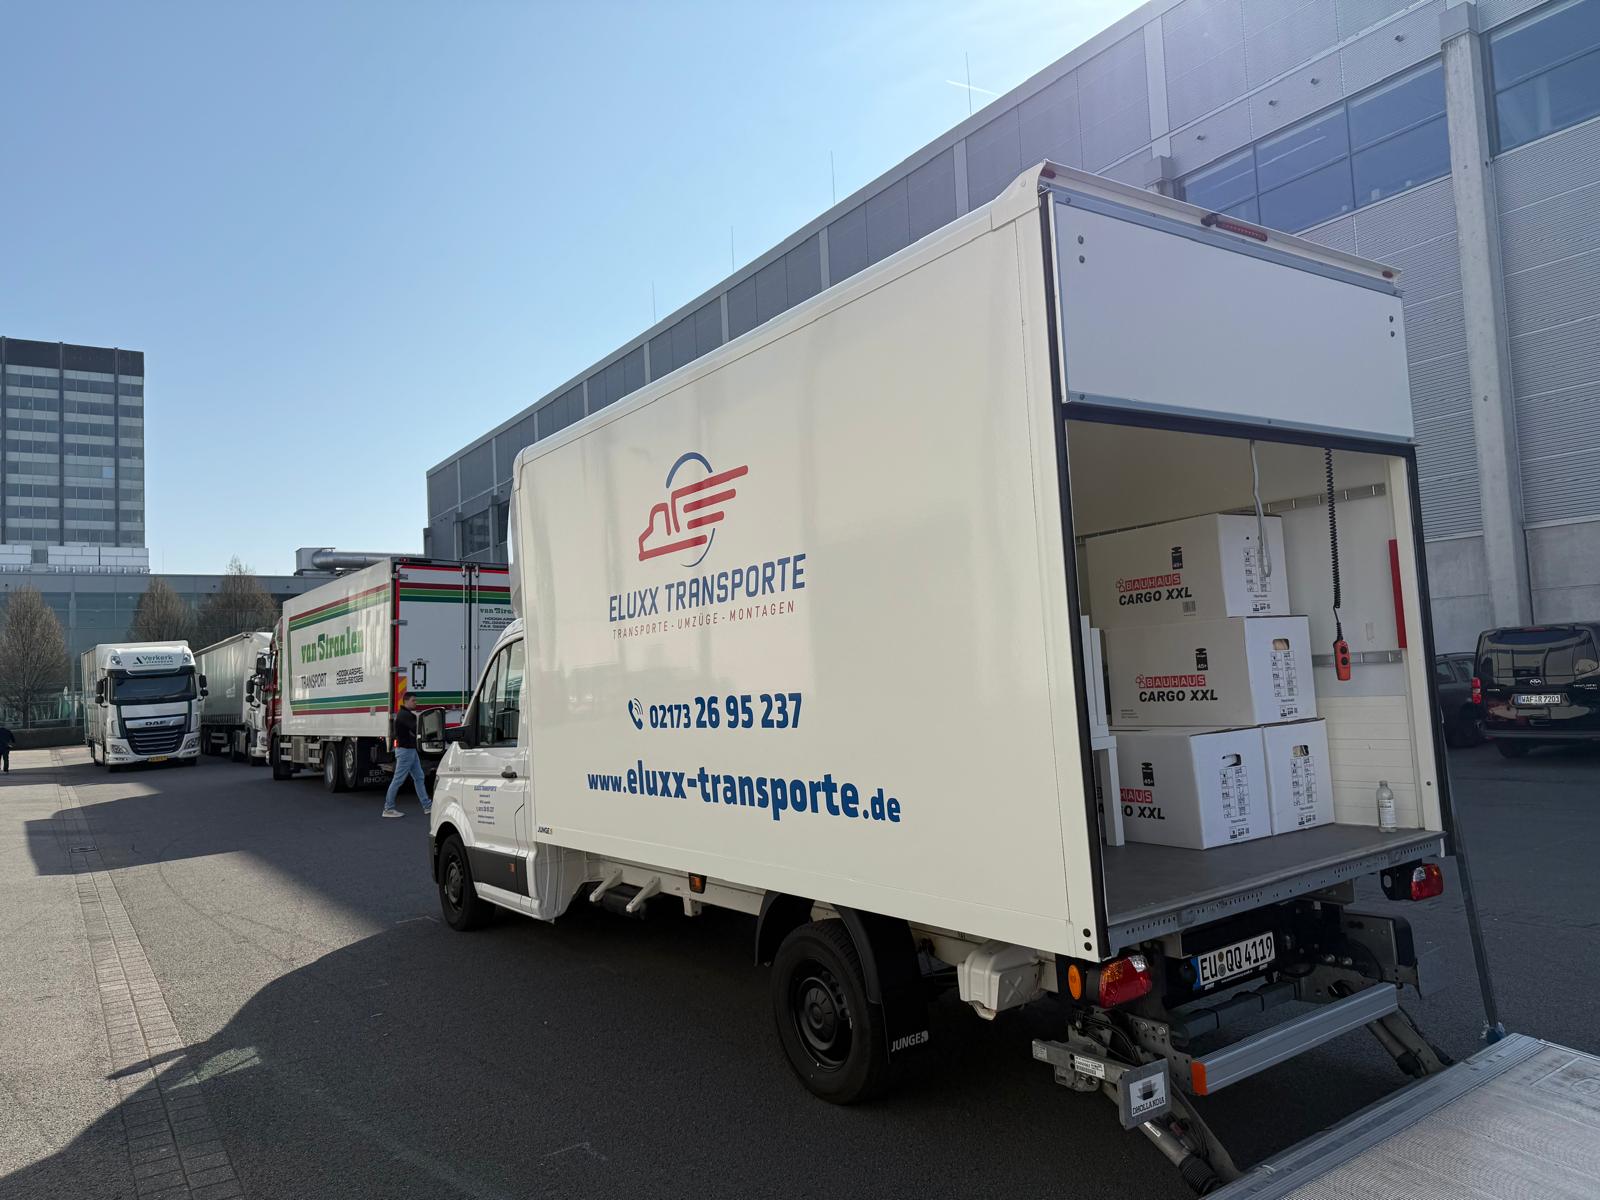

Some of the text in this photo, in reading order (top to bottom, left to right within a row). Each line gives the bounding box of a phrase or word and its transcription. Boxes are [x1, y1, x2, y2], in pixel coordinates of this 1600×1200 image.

[609, 553, 807, 623] ELUXX TRANSPORTE
[1125, 574, 1181, 592] BAUHAUS
[1119, 587, 1193, 606] CARGO XXL
[612, 620, 668, 641] TRANSPORTE
[677, 612, 719, 630] UMZÜGE
[729, 600, 796, 622] MONTAGEN
[300, 626, 364, 664] van Straalen
[300, 672, 327, 690] TRANSPORT
[1145, 674, 1206, 689] BAUHAUS
[1139, 689, 1219, 703] CARGO XXL
[649, 692, 802, 729] 02173 26 95 237
[587, 759, 901, 823] www.eluxx-transporte.de
[1137, 806, 1166, 820] XXL
[1201, 953, 1219, 982] EU
[1225, 946, 1243, 973] QQ
[1245, 935, 1273, 966] 4119
[890, 1032, 921, 1053] JUNGE
[1132, 1096, 1165, 1115] DHOLLANDIA
